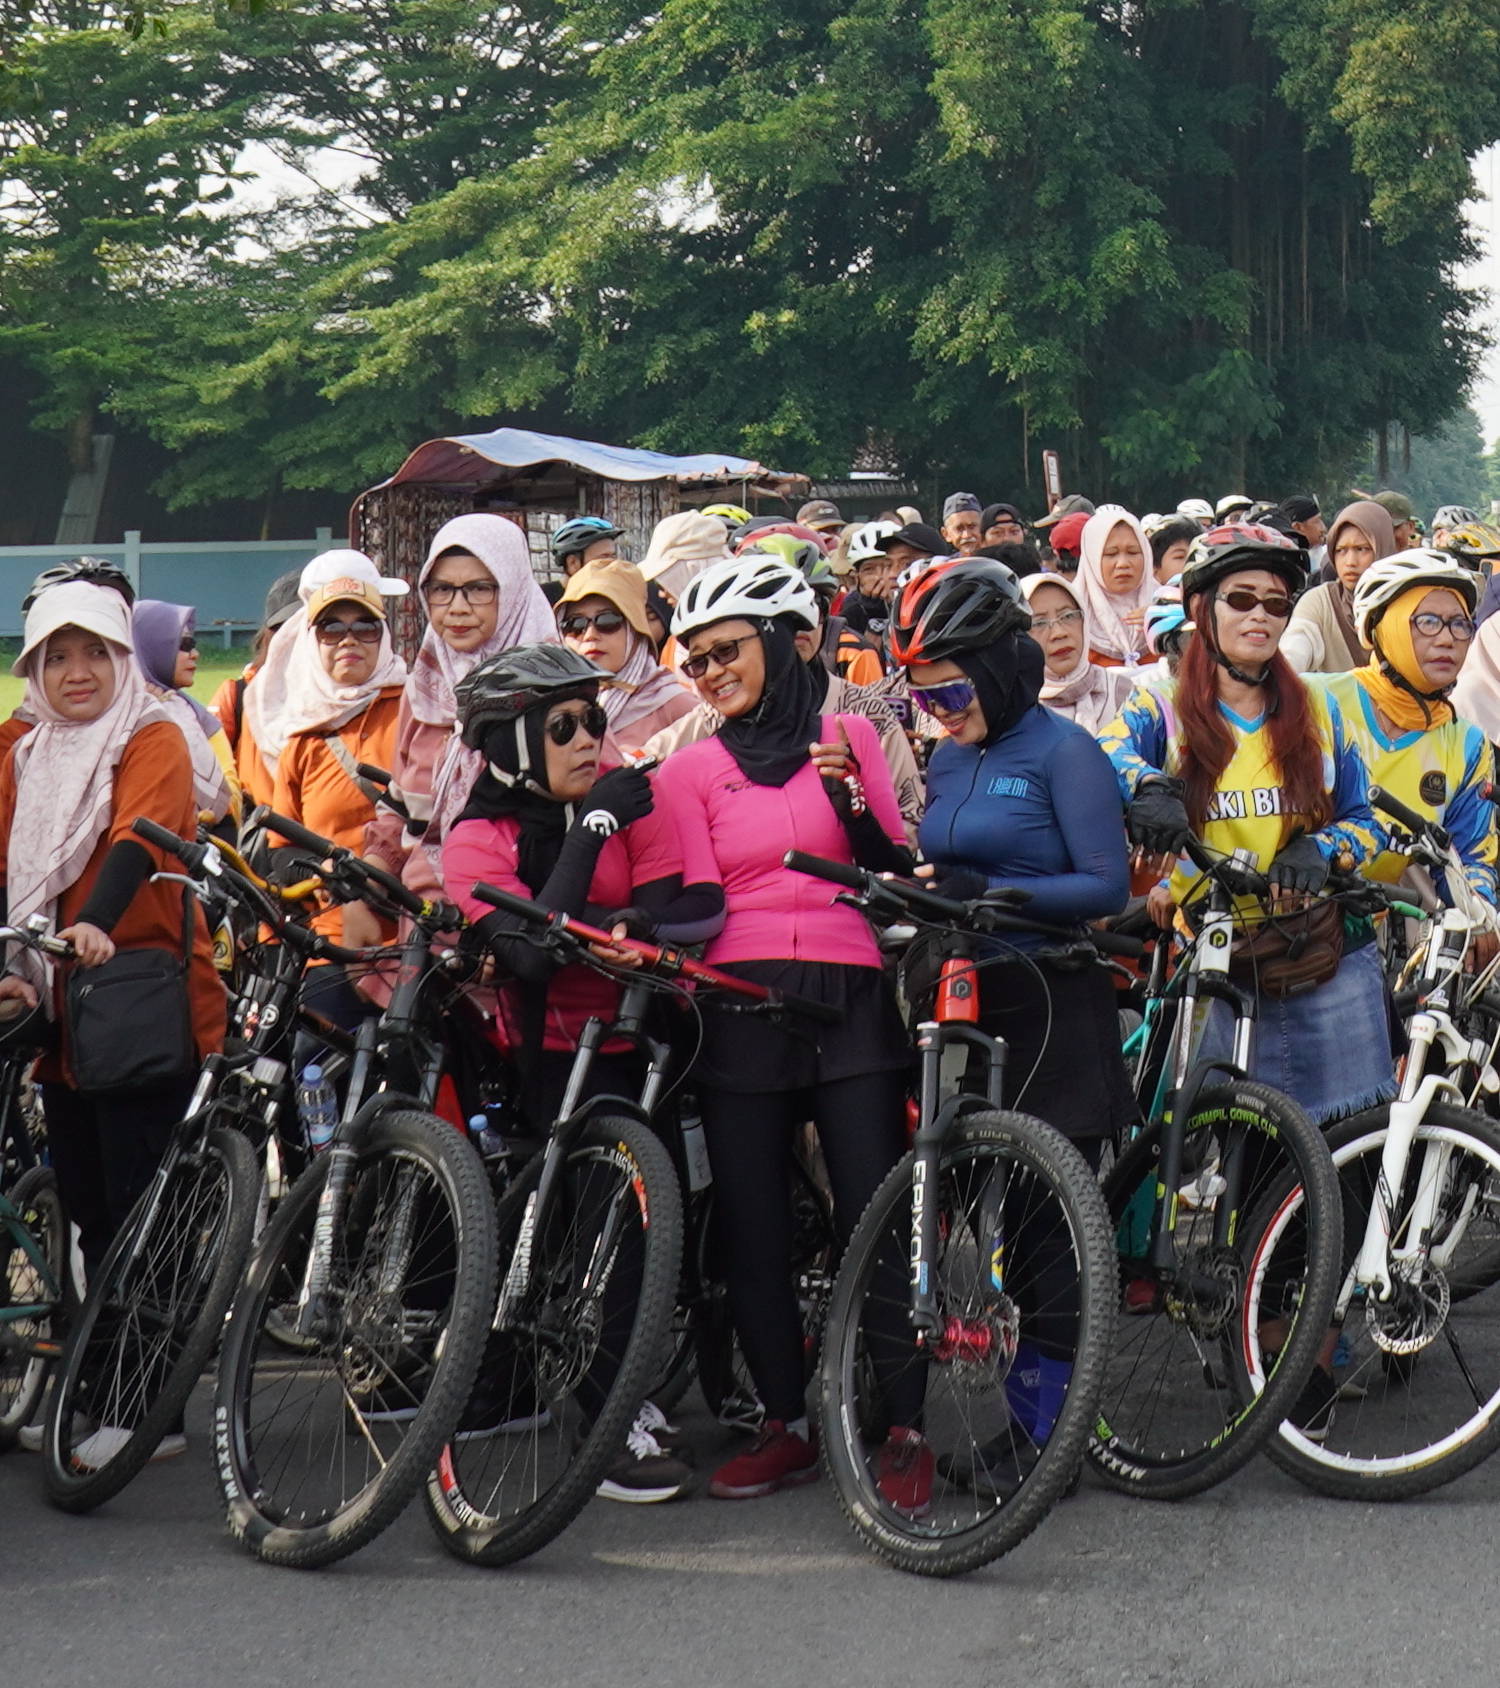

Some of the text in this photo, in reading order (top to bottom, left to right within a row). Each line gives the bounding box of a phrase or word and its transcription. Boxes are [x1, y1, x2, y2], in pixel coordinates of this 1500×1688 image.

[909, 1160, 926, 1286] EPIXON
[216, 1406, 240, 1500] MAXXIS
[1089, 1437, 1148, 1480] MAXXIS
